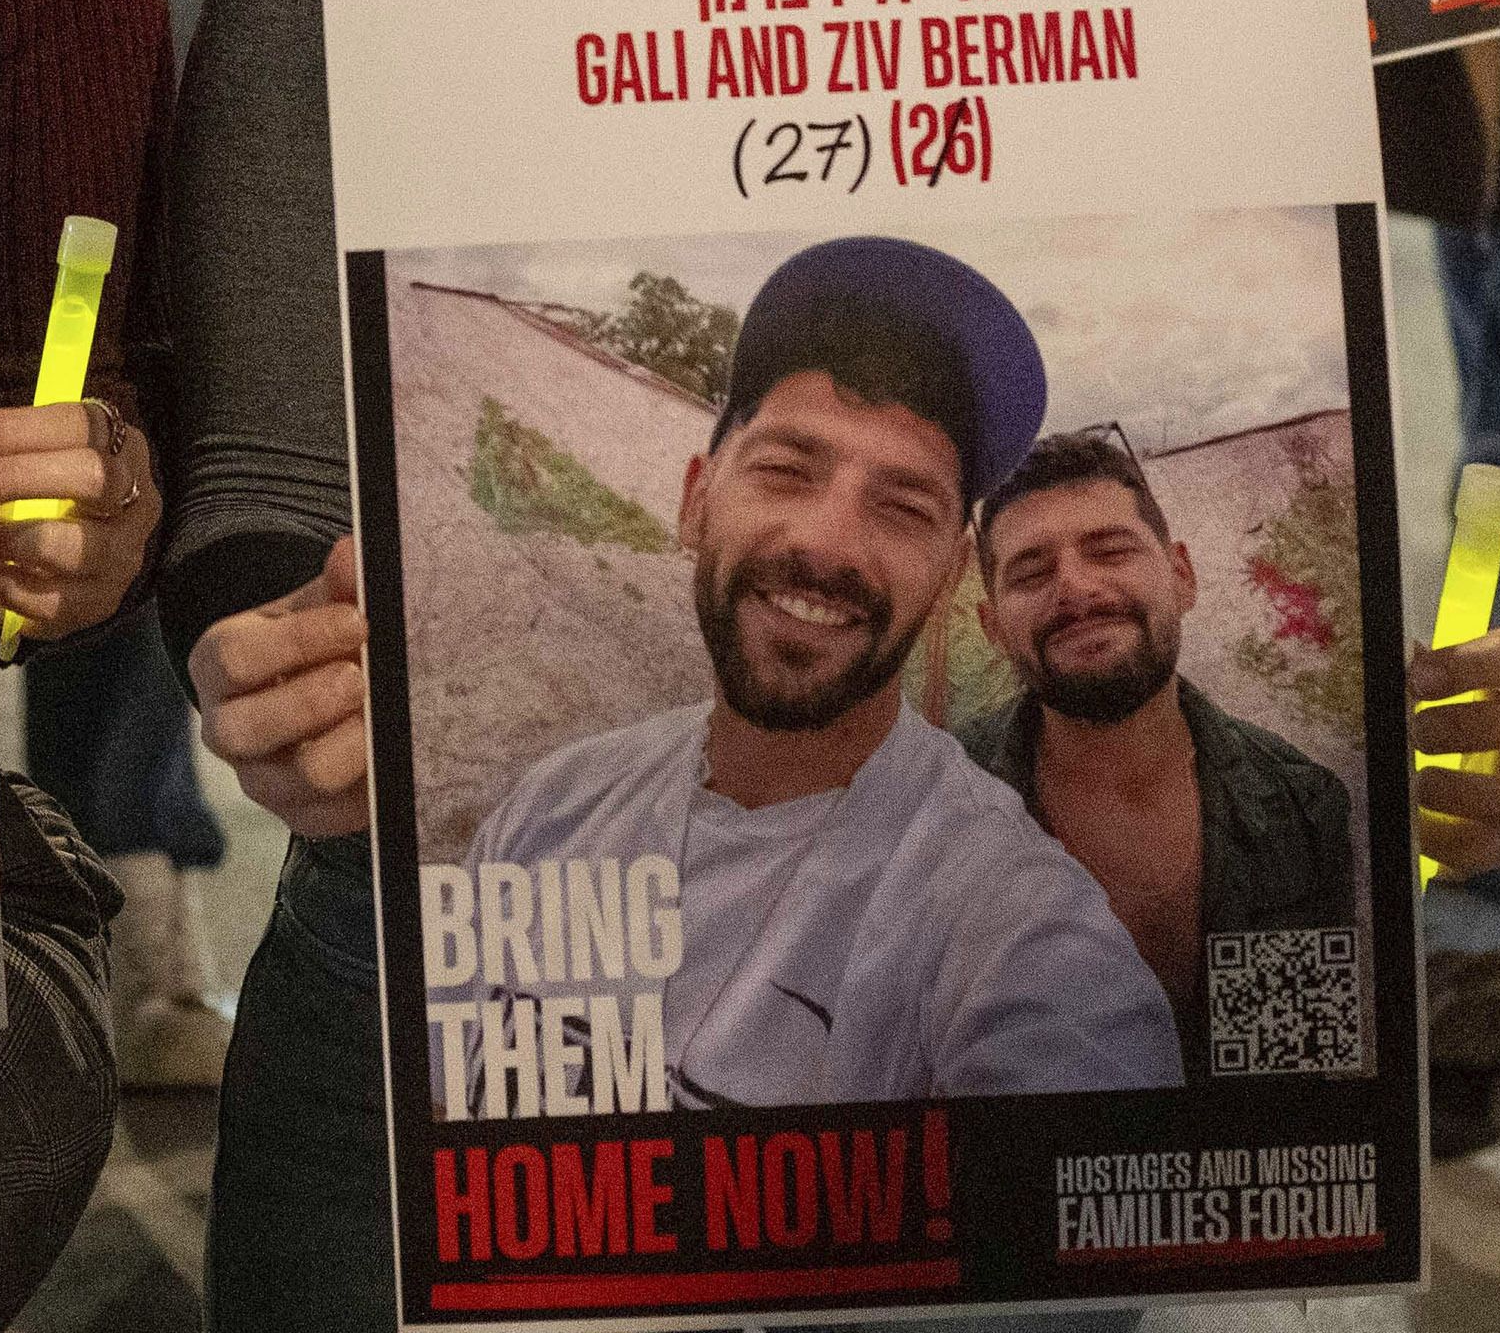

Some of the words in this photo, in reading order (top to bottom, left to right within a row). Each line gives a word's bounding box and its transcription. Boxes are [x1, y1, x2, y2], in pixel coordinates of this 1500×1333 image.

[576, 30, 688, 105] GALI
[708, 25, 808, 99] AND
[823, 19, 901, 93] ZIV
[921, 8, 1137, 88] BERMAN
[733, 114, 871, 198] (27)
[891, 96, 991, 187] (26)
[419, 854, 682, 987] BRING
[426, 993, 671, 1121] THEM
[435, 1140, 676, 1261] HOME
[704, 1116, 946, 1250] NOW!
[1057, 1152, 1191, 1193] HOSTAGES
[1198, 1149, 1251, 1187] AND
[1258, 1143, 1375, 1184] MISSING
[1058, 1190, 1229, 1250] FAMILIES
[1241, 1184, 1376, 1242] FORUM
